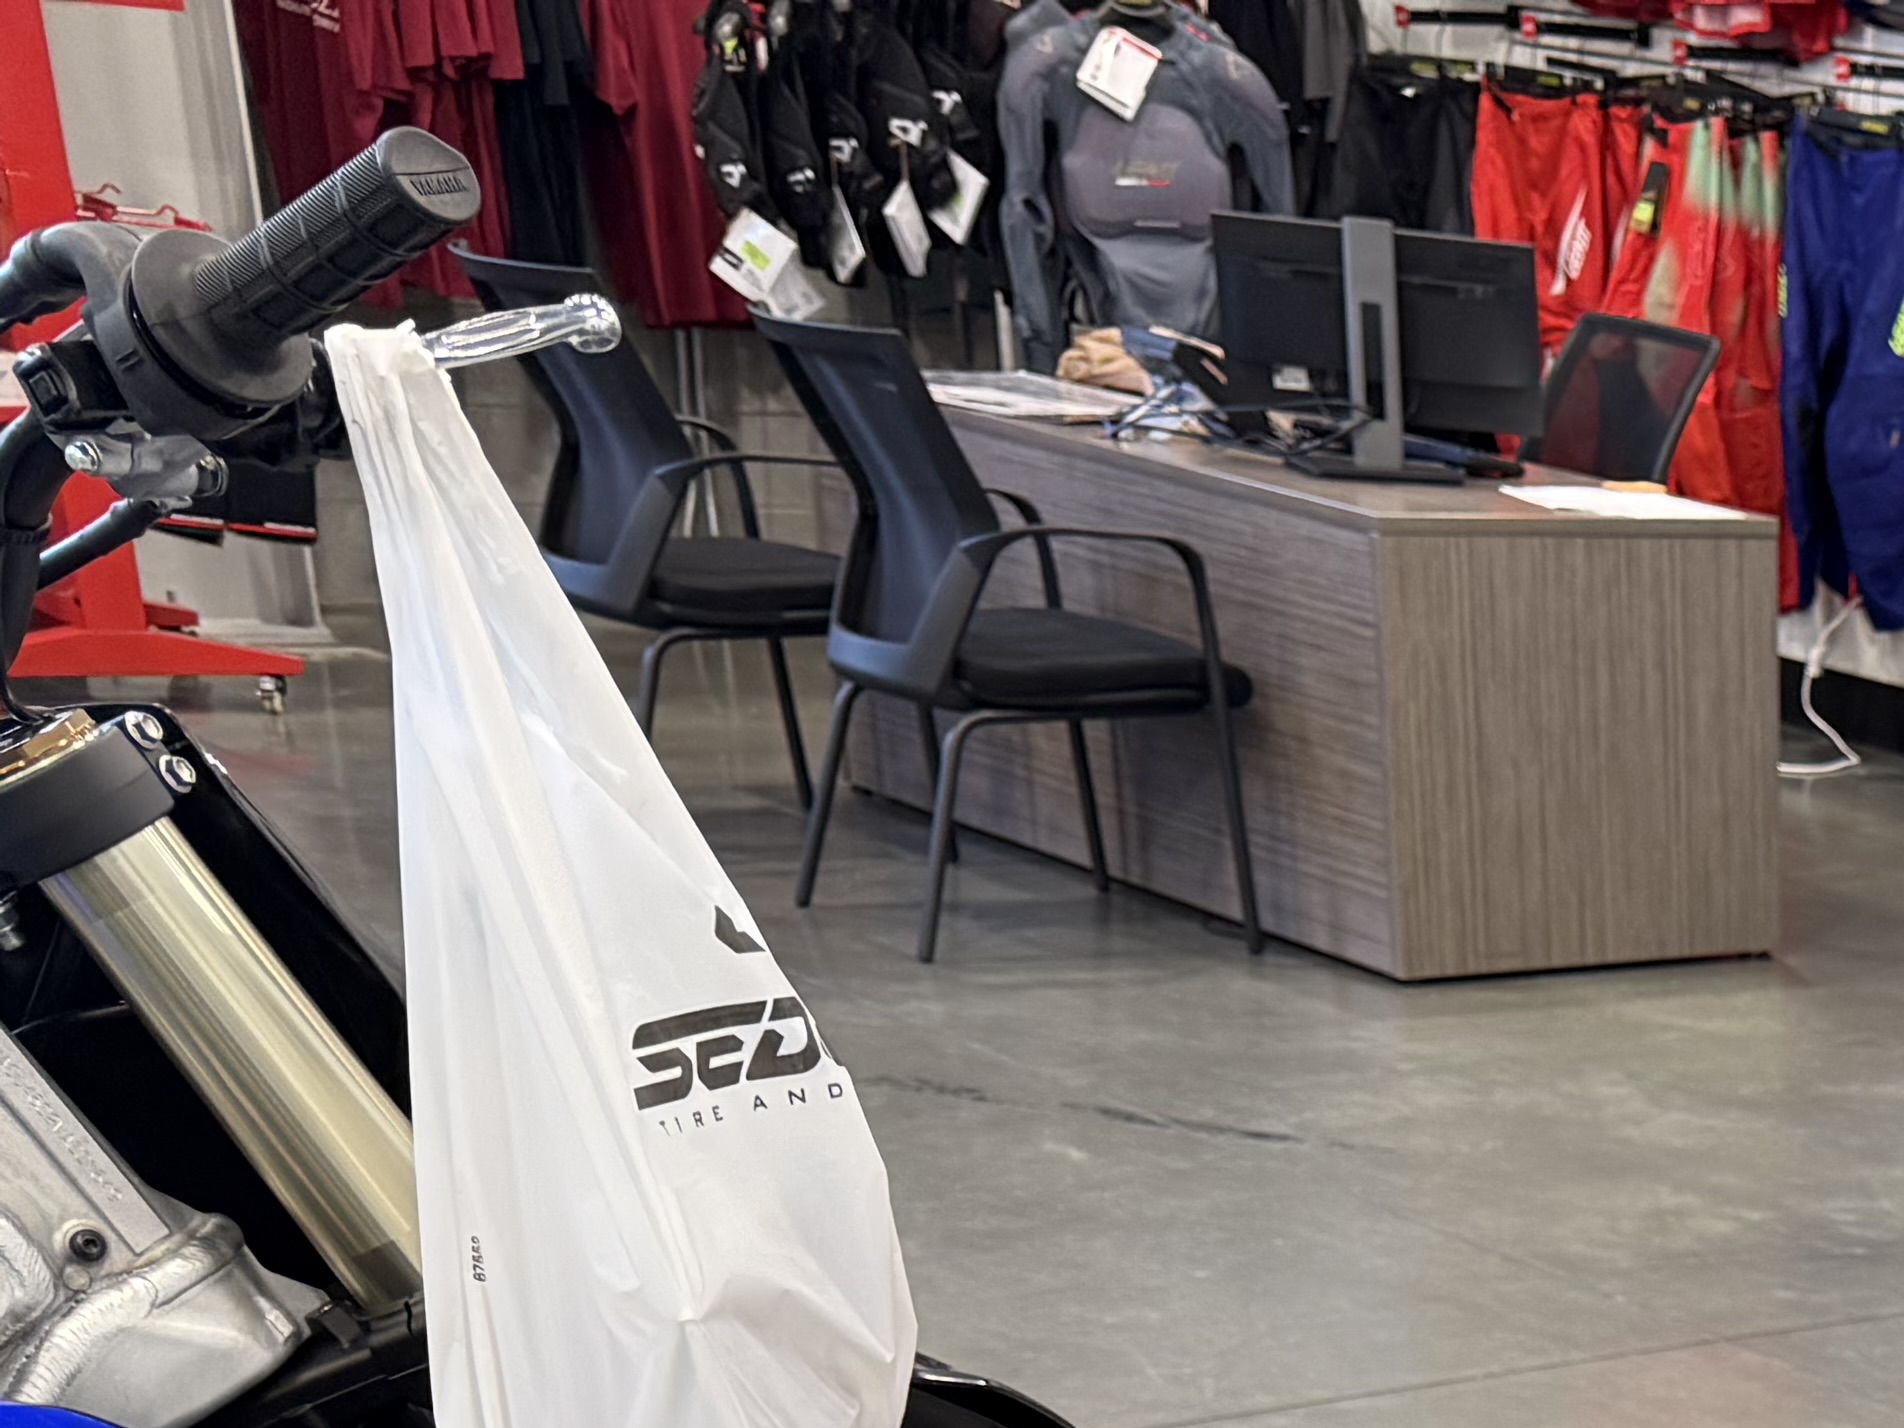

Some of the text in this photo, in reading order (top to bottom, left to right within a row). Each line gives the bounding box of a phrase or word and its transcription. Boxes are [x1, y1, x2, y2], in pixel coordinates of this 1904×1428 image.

[632, 996, 828, 1111] SED
[659, 1082, 843, 1137] TIRE AND
